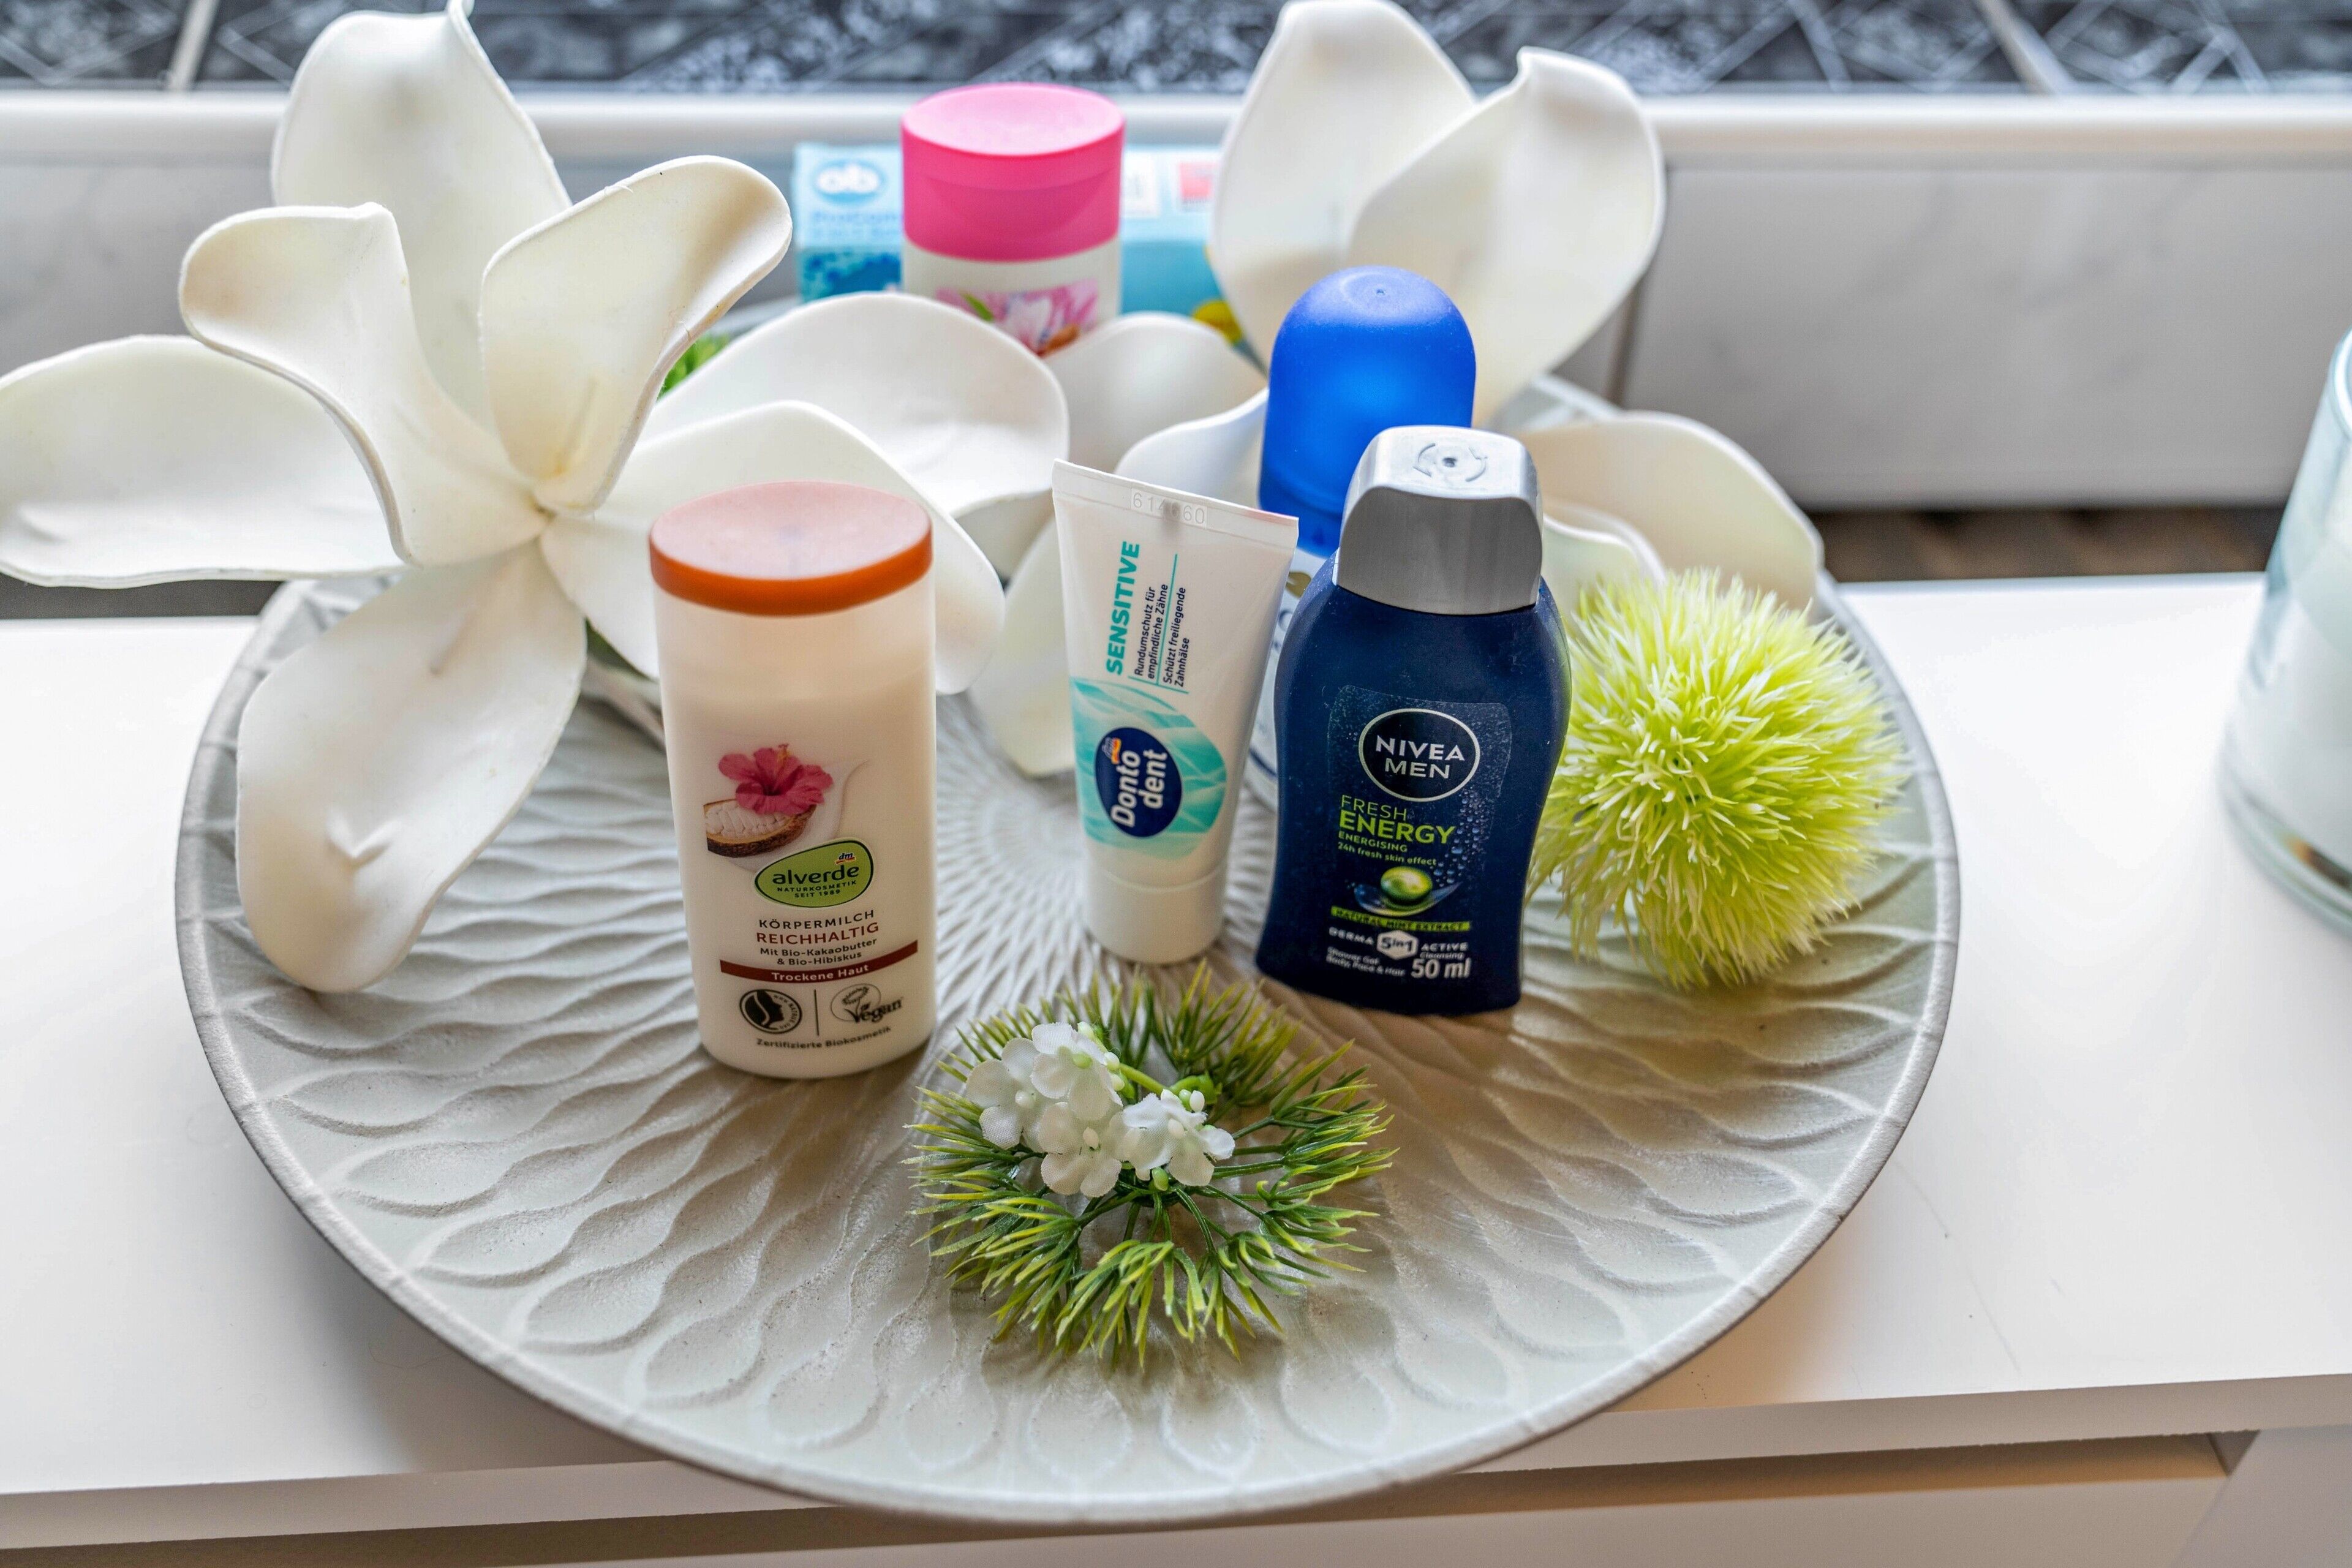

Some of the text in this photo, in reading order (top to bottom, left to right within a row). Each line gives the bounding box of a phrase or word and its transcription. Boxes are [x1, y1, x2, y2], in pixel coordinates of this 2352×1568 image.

[1106, 541, 1140, 675] SENSITIVE
[1135, 586, 1155, 676] Rundumschutz für
[1147, 584, 1169, 679] empfindliche Zähne
[1164, 587, 1186, 684] Schützt freiliegende
[1174, 638, 1189, 687] Zahnhälse
[1376, 735, 1465, 761] NIVEA
[1138, 749, 1167, 809] dent
[1385, 758, 1450, 778] MEN
[1110, 750, 1141, 827] Donto
[1341, 794, 1407, 821] FRESH
[1340, 809, 1456, 844] ENERGY
[1338, 831, 1408, 852] ENERGISING
[1338, 842, 1436, 866] 24h fresh skin effect
[772, 865, 859, 884] alverde
[777, 880, 856, 892] NATURKOSMETIK
[759, 910, 874, 929] KÖRPERMILCH
[756, 922, 879, 944] REICHHALTIG
[1329, 927, 1374, 945] DERMA
[782, 938, 876, 956] Bio-Kakaobutter
[1421, 943, 1468, 951] ACTIVE
[788, 952, 862, 965] Bio-Hibiskus
[1411, 958, 1471, 979] 50 ml
[771, 965, 869, 981] Trockene Haut
[757, 1026, 891, 1049] Zertifizierte Biokosmetik
